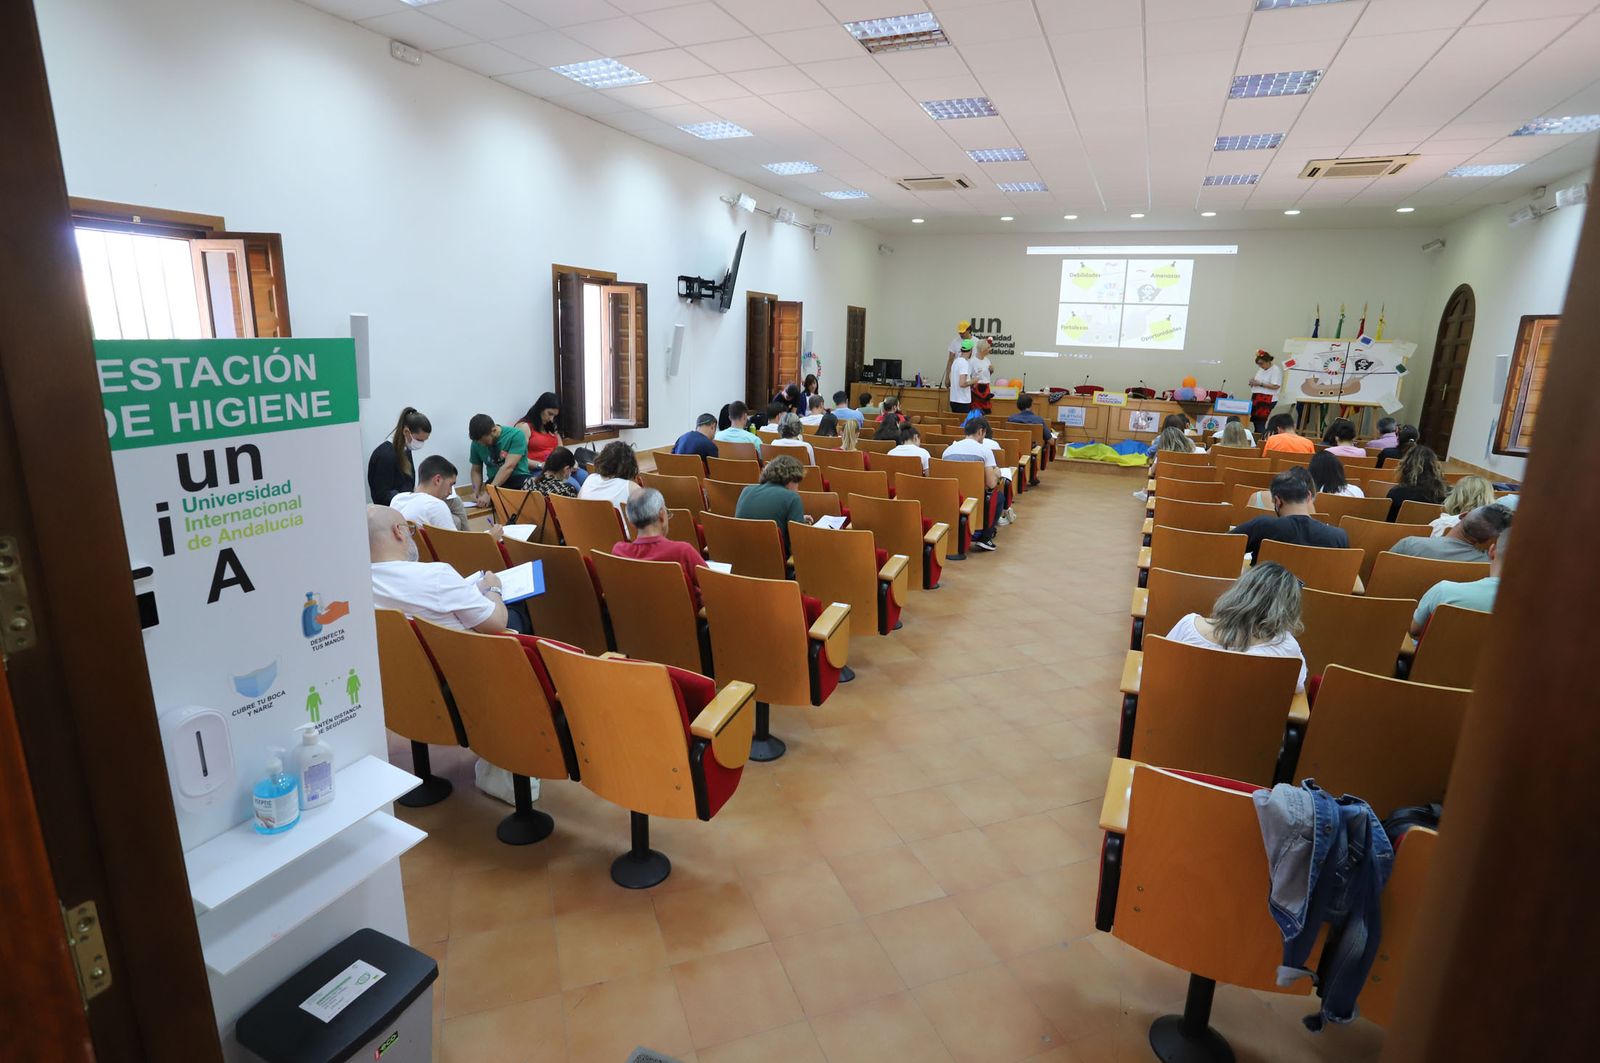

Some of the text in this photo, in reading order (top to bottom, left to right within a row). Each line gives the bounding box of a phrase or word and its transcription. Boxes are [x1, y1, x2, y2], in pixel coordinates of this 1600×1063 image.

[96, 347, 317, 393] ESTACIÓN
[169, 390, 332, 433] HIGIENE
[176, 443, 263, 492] un
[182, 480, 292, 513] Universidad
[185, 495, 302, 532] Internacional
[187, 513, 304, 551] de Andalucía
[207, 547, 256, 604] A
[310, 628, 345, 646] DESINFECTA
[312, 635, 345, 651] TUS MANOS
[231, 690, 286, 717] CUBRE TU BOCA
[253, 701, 273, 715] NARIZ
[314, 704, 362, 730] ANTÉN DISTANCIA
[325, 712, 357, 732] SEGURIDAD
